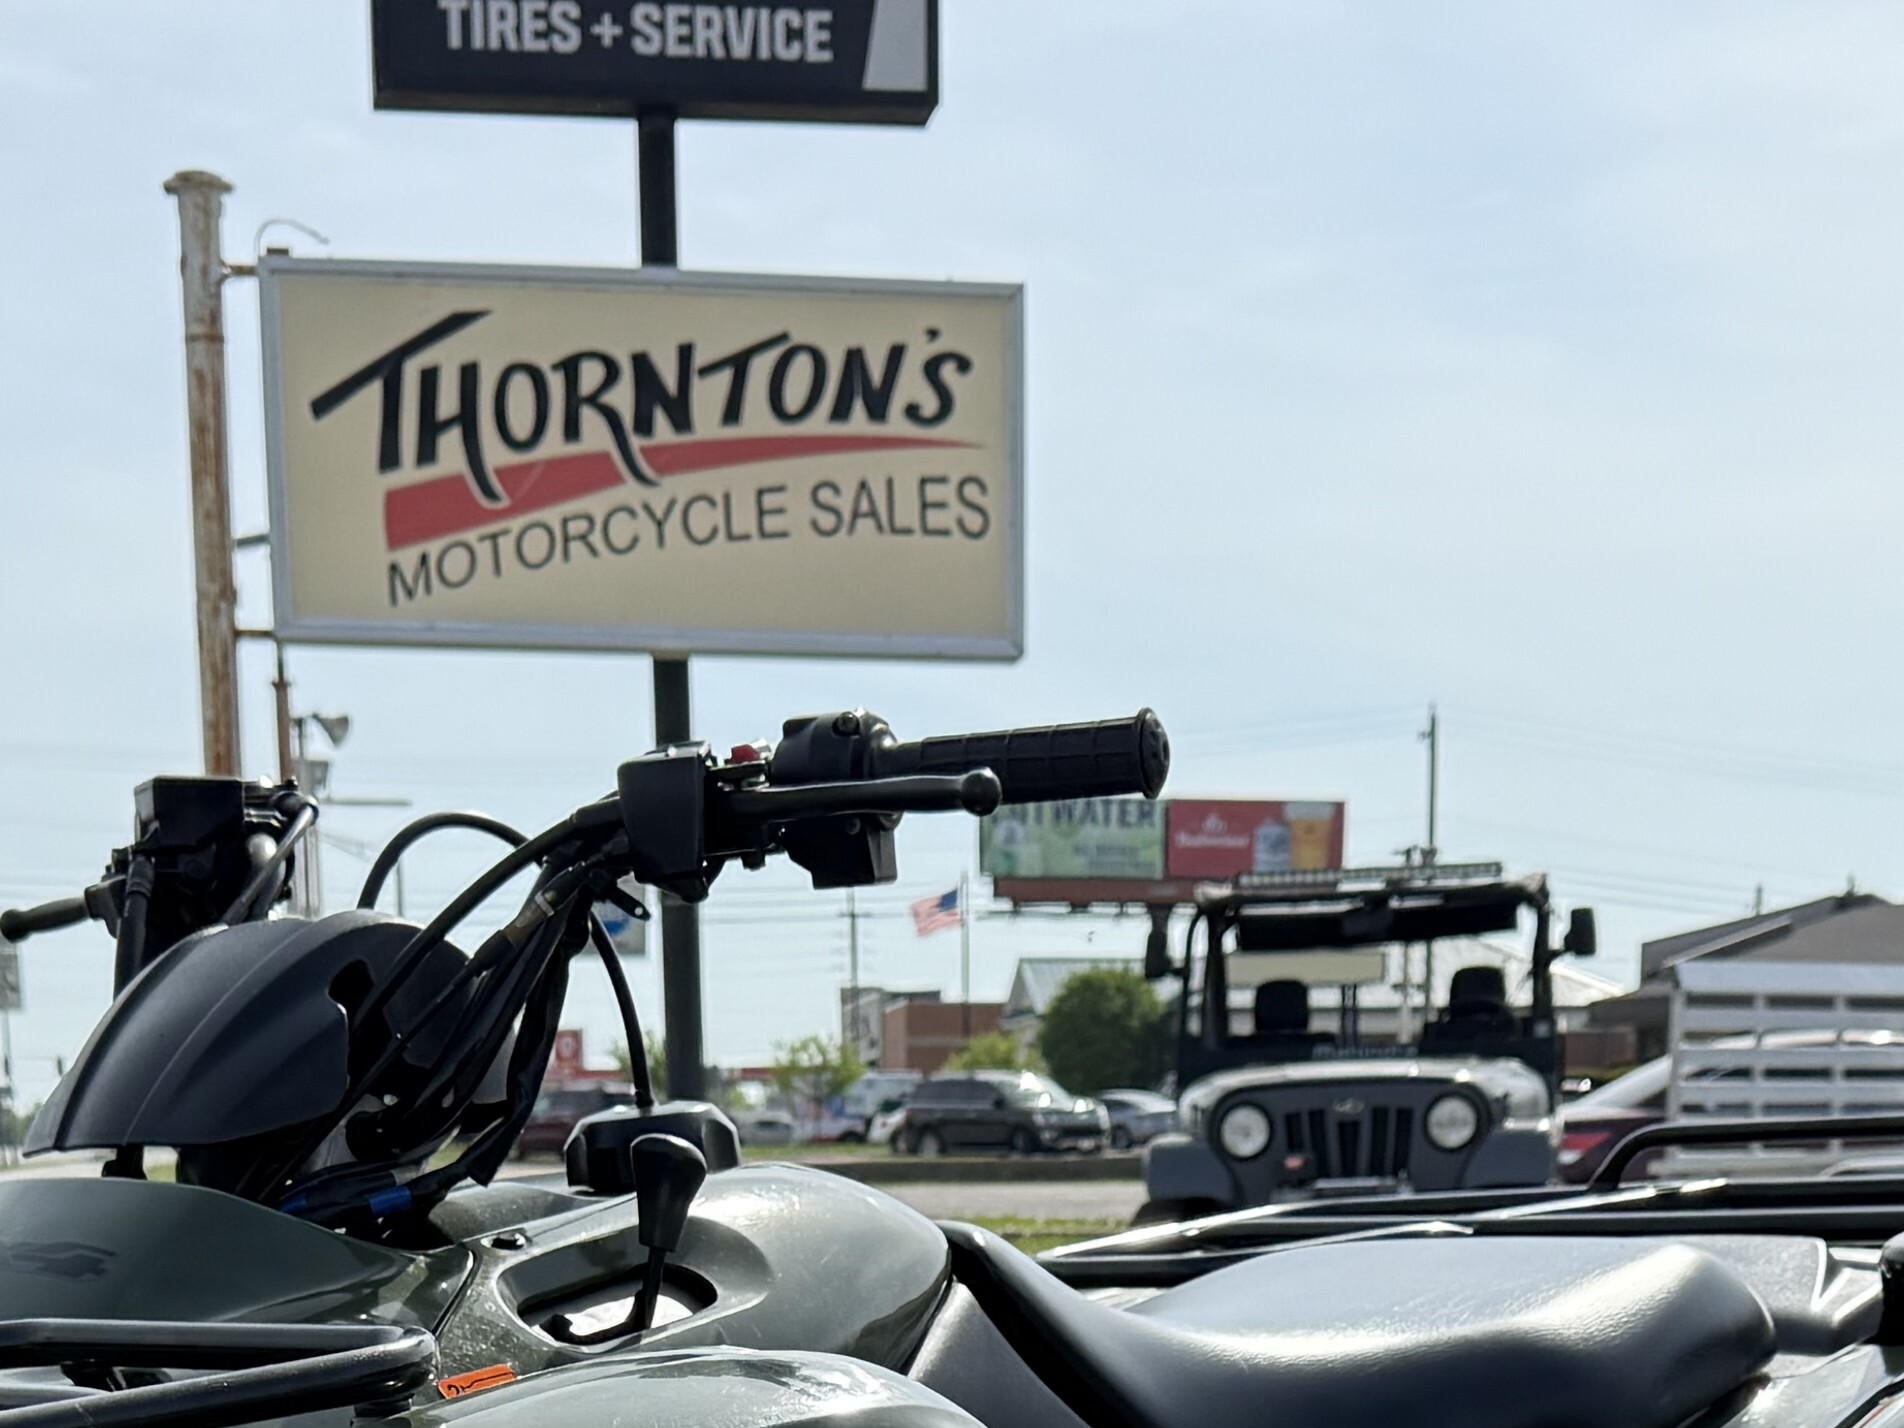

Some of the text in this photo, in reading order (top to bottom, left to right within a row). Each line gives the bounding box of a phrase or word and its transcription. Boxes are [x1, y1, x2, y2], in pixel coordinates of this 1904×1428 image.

[437, 0, 582, 54] TIRES
[630, 2, 835, 63] SERVICE
[312, 310, 972, 507] THORNTON'S
[388, 474, 992, 607] MOTORCYCLE SALES
